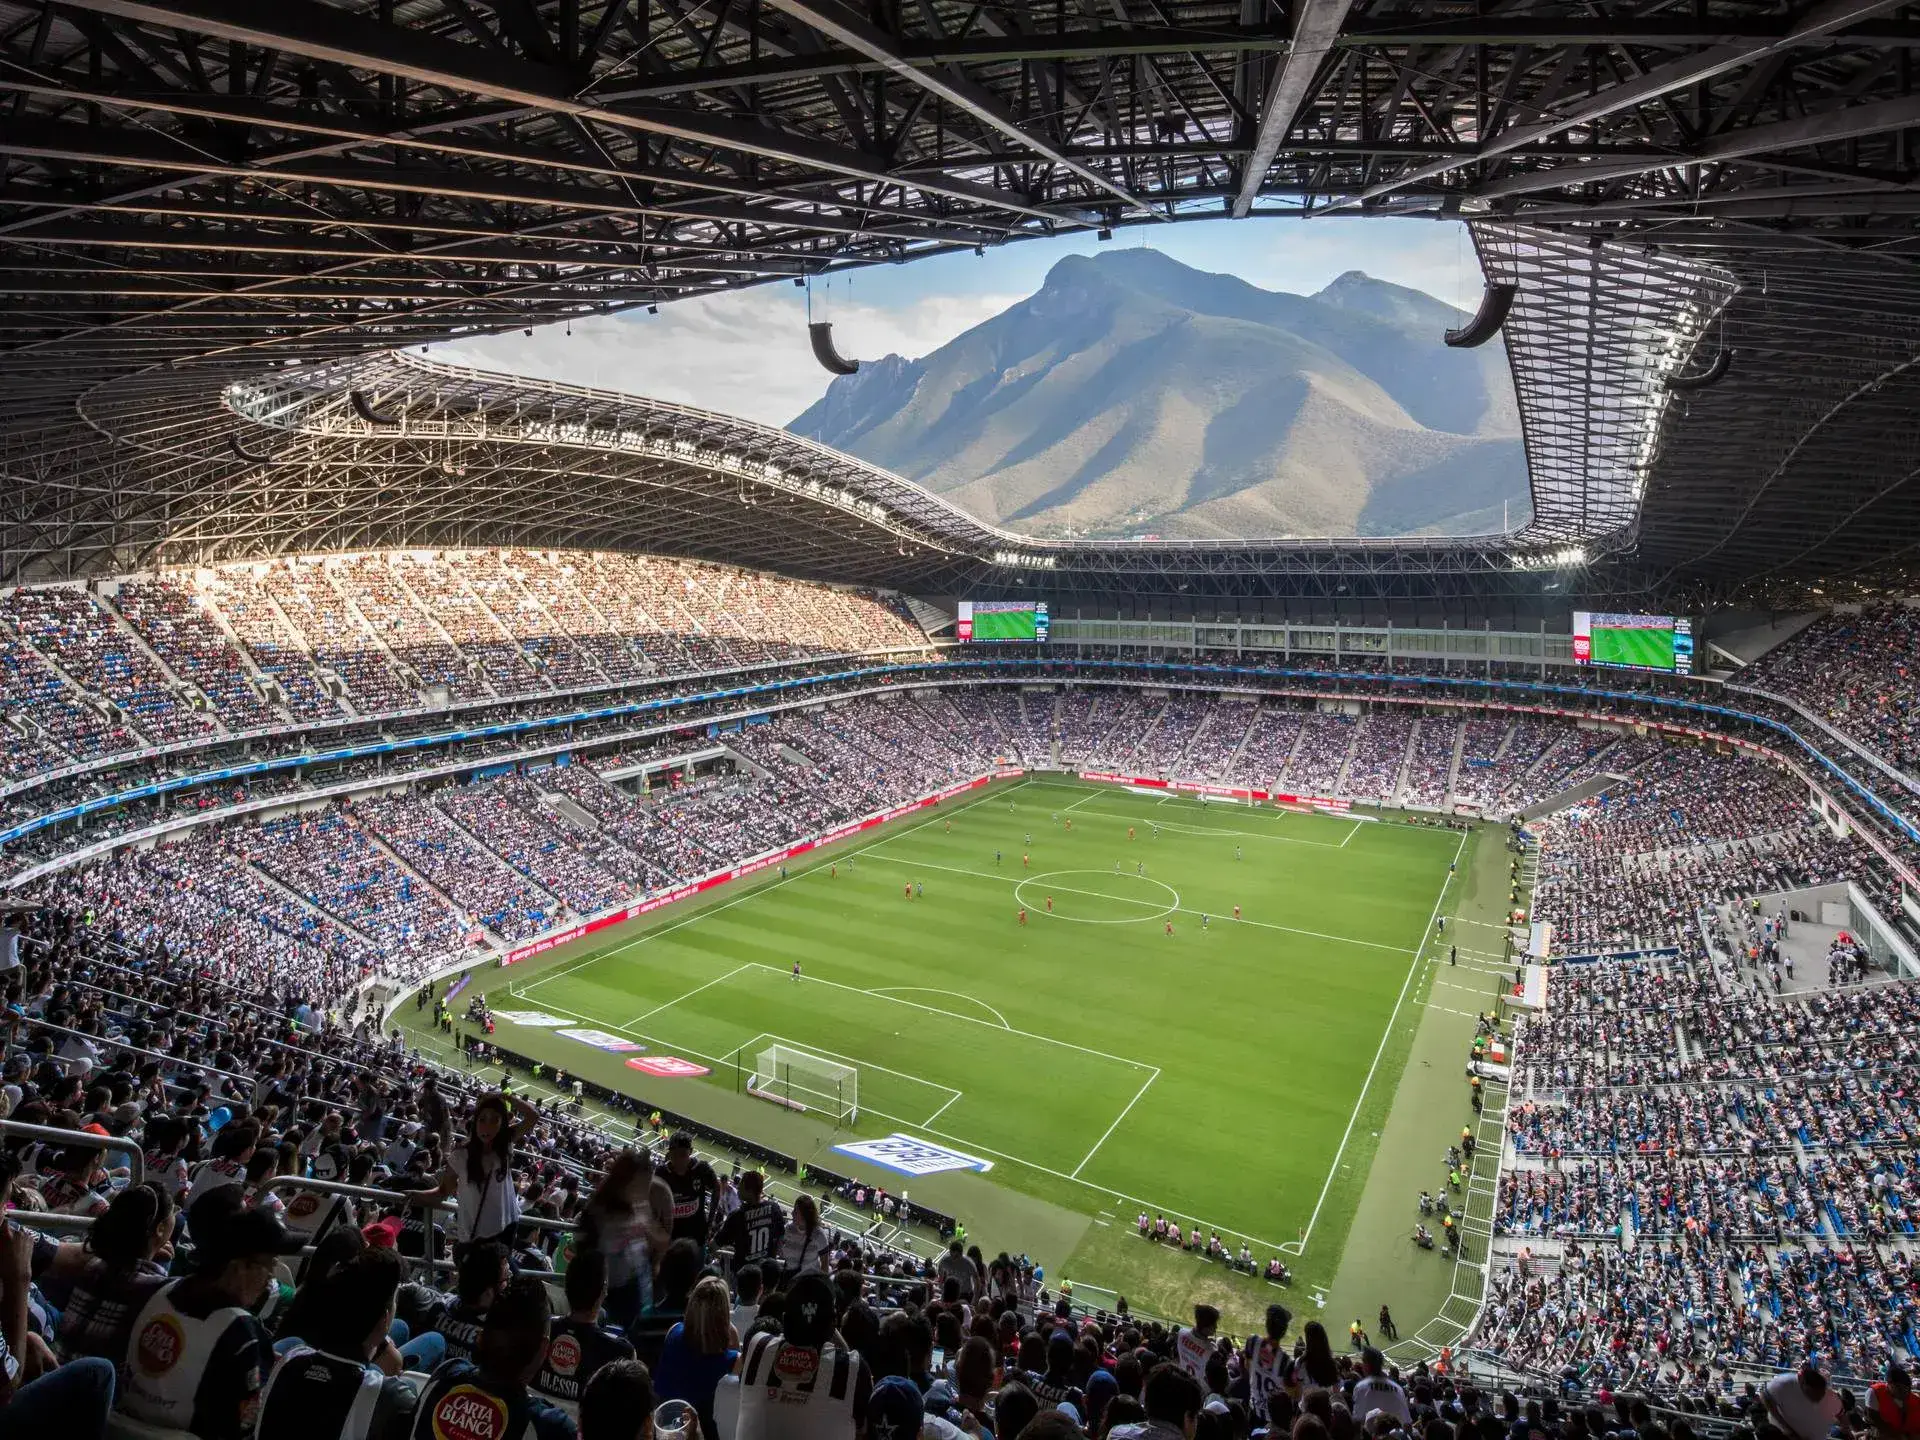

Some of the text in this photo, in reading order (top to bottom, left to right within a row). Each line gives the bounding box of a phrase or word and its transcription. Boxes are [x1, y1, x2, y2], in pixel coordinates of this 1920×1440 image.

[749, 1226, 770, 1254] 10
[439, 1403, 493, 1438] BLANCA
[452, 1395, 494, 1423] CARTA
